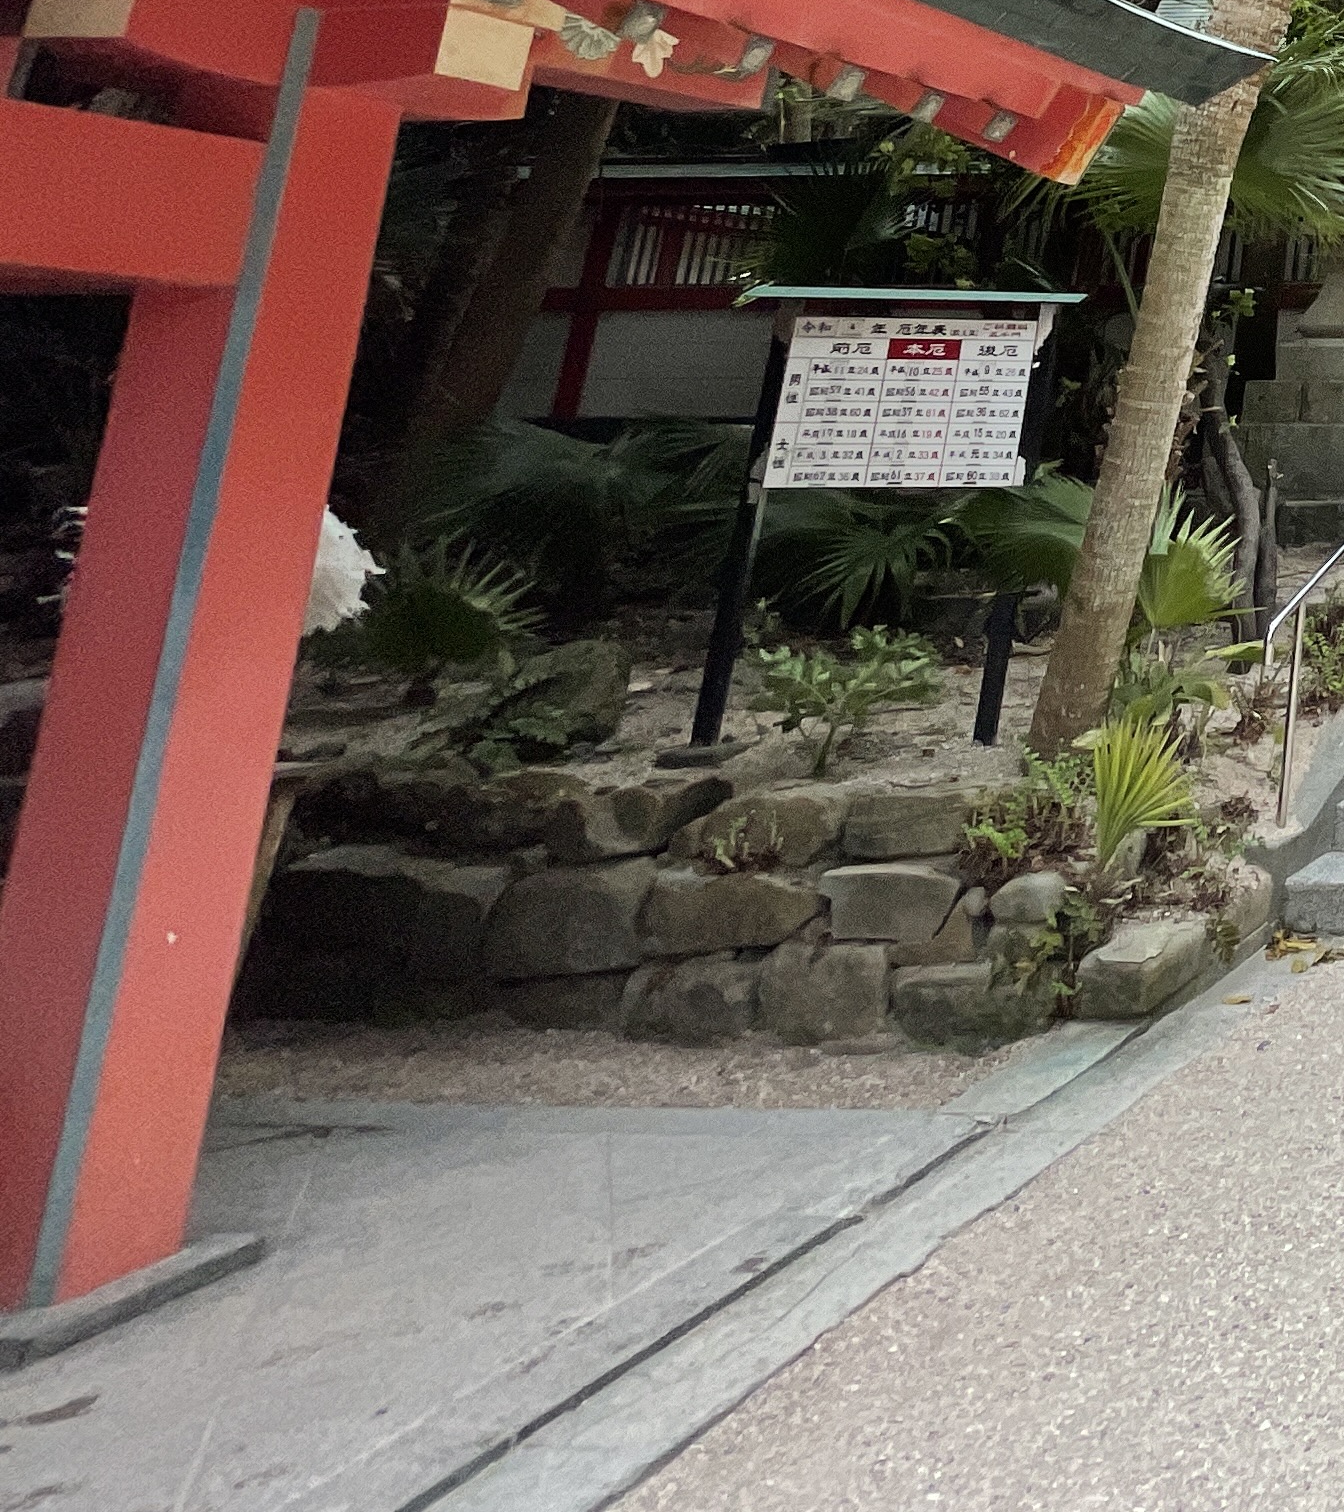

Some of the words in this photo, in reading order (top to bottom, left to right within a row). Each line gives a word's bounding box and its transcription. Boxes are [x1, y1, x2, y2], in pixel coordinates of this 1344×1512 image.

[829, 342, 873, 355] 前厄
[902, 342, 946, 356] 本厄
[976, 345, 1019, 357] 後厄
